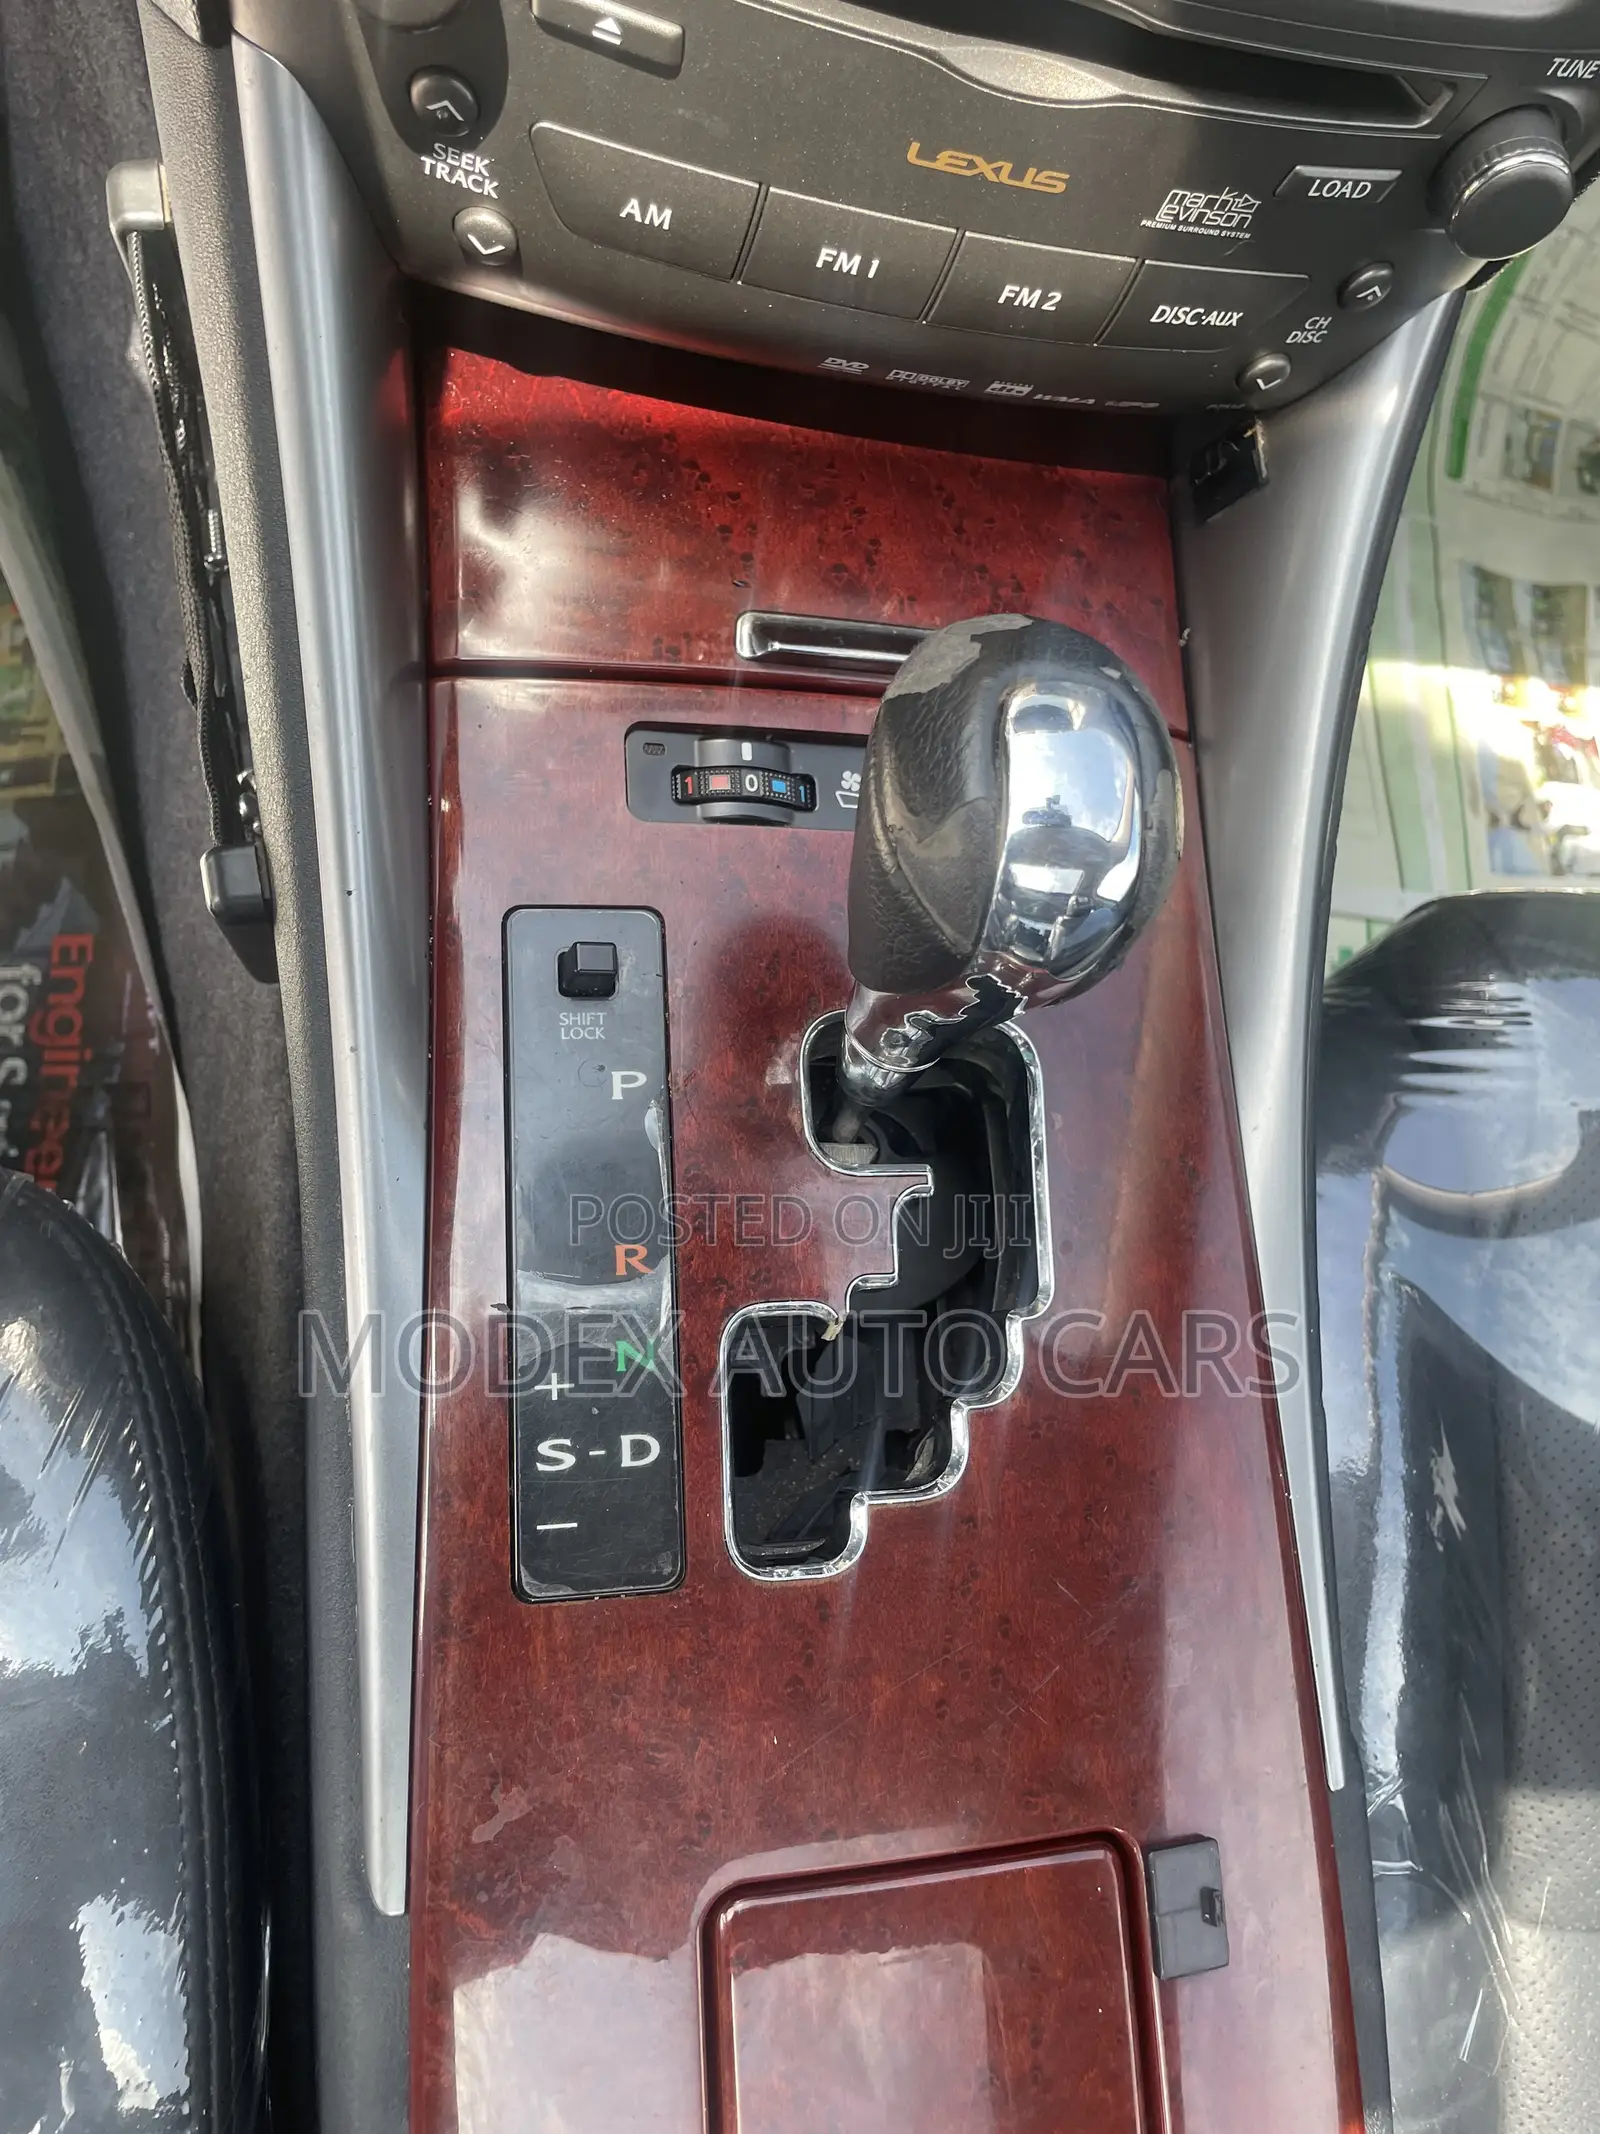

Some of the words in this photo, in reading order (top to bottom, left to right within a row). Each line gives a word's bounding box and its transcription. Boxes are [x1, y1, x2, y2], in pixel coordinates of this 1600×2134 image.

[1546, 57, 1600, 79] TUNE
[432, 142, 491, 177] SEEK
[906, 141, 1071, 195] LEXUS
[420, 156, 500, 200] TRACK
[1308, 179, 1372, 200] LOAD
[619, 198, 673, 231] AM
[1140, 219, 1177, 231] PREMIUM
[1177, 224, 1220, 237] SURROUND
[1220, 229, 1251, 240] SYSTEM
[1304, 316, 1333, 330] CH
[1285, 330, 1329, 345] DISC
[822, 356, 870, 371] DVD
[917, 373, 970, 388] DOLBY
[684, 775, 694, 796] 1
[745, 773, 759, 792] 0
[798, 784, 806, 803] 1
[559, 1012, 607, 1026] SHIFT
[561, 1027, 606, 1040] LOCK
[611, 1071, 647, 1100] P
[614, 1244, 653, 1276] R
[616, 1339, 656, 1372] N
[536, 1438, 577, 1472] S
[620, 1434, 661, 1468] D
